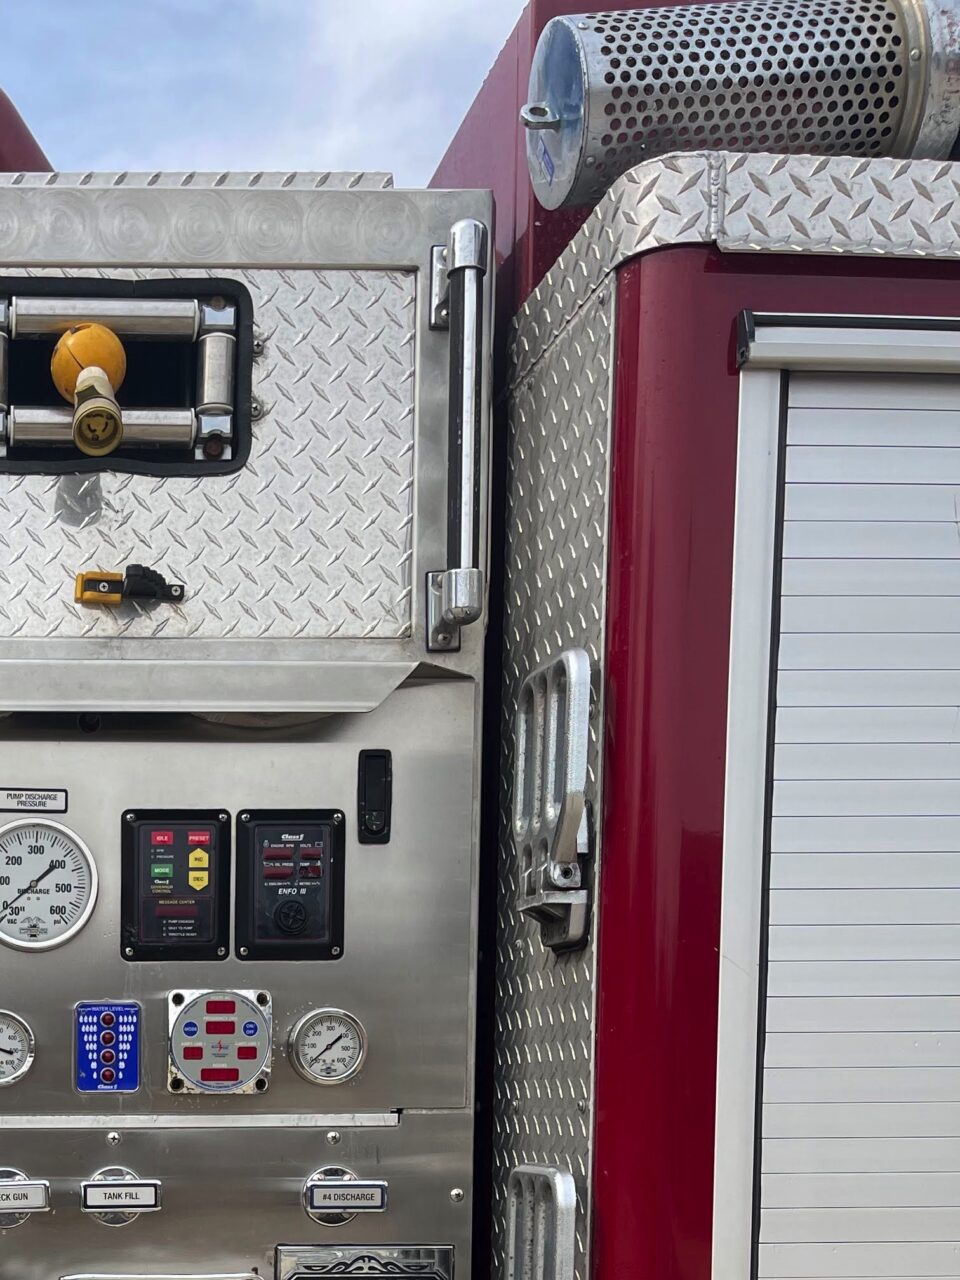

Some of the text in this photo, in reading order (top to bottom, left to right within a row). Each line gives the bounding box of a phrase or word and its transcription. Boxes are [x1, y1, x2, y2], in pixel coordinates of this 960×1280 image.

[28, 845, 44, 855] 300
[6, 856, 22, 866] 200
[48, 859, 66, 869] 400
[55, 884, 72, 893] 500
[2, 900, 8, 910] 0
[50, 905, 66, 915] 600
[103, 1192, 123, 1200] TANK
